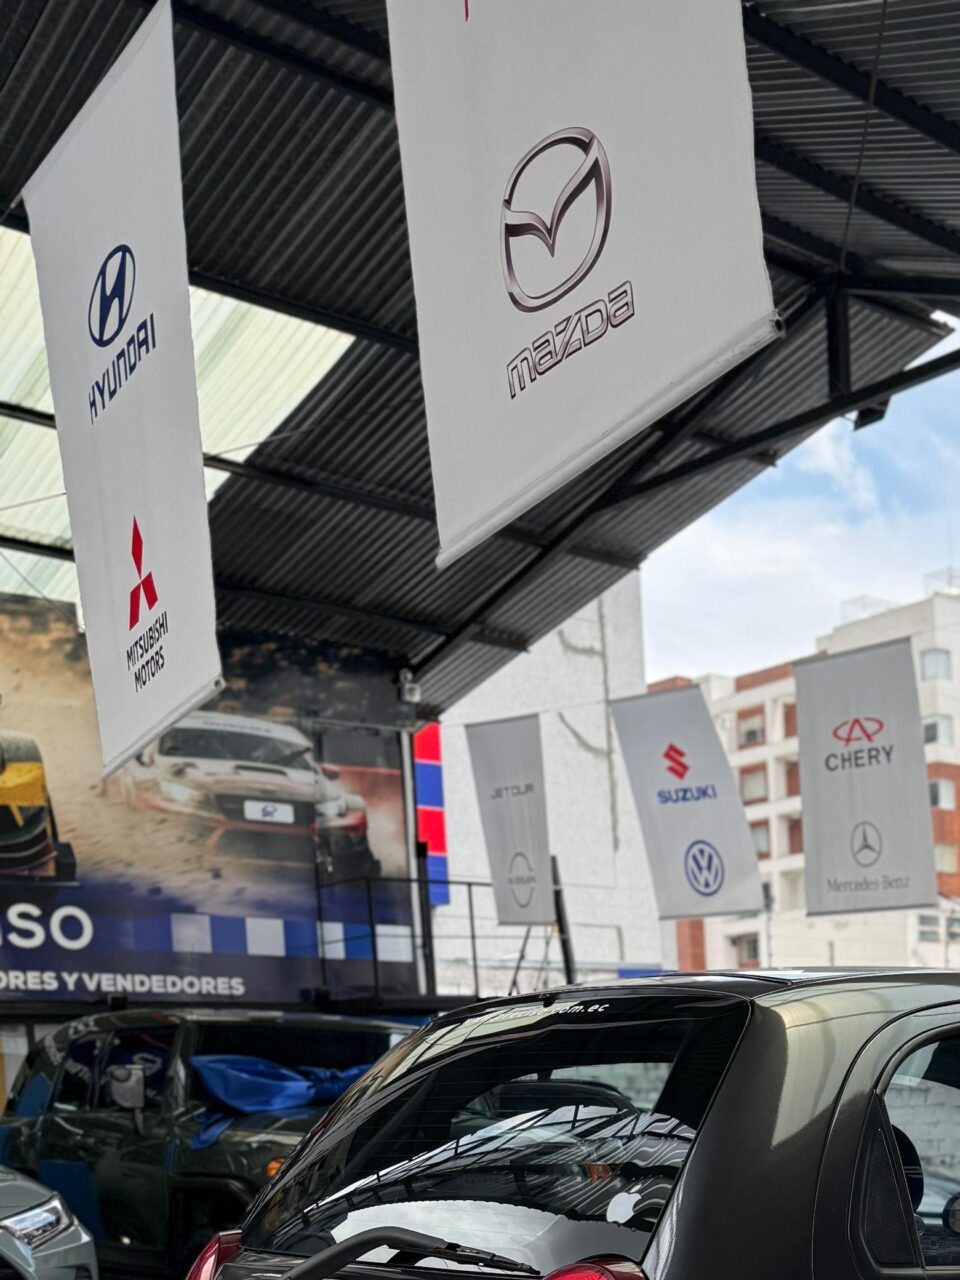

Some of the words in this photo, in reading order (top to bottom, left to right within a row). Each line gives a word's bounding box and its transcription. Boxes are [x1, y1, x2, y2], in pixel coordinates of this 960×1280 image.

[88, 312, 157, 425] HYUNDAI
[126, 610, 169, 672] MITSUBISHI
[134, 645, 166, 693] MOTORS
[825, 745, 894, 772] CHERY
[657, 783, 717, 805] SUZUKI
[826, 875, 910, 893] Mercedes-Benz
[0, 903, 94, 950] SO
[61, 971, 79, 992] Y
[81, 972, 245, 995] VENDEDORES
